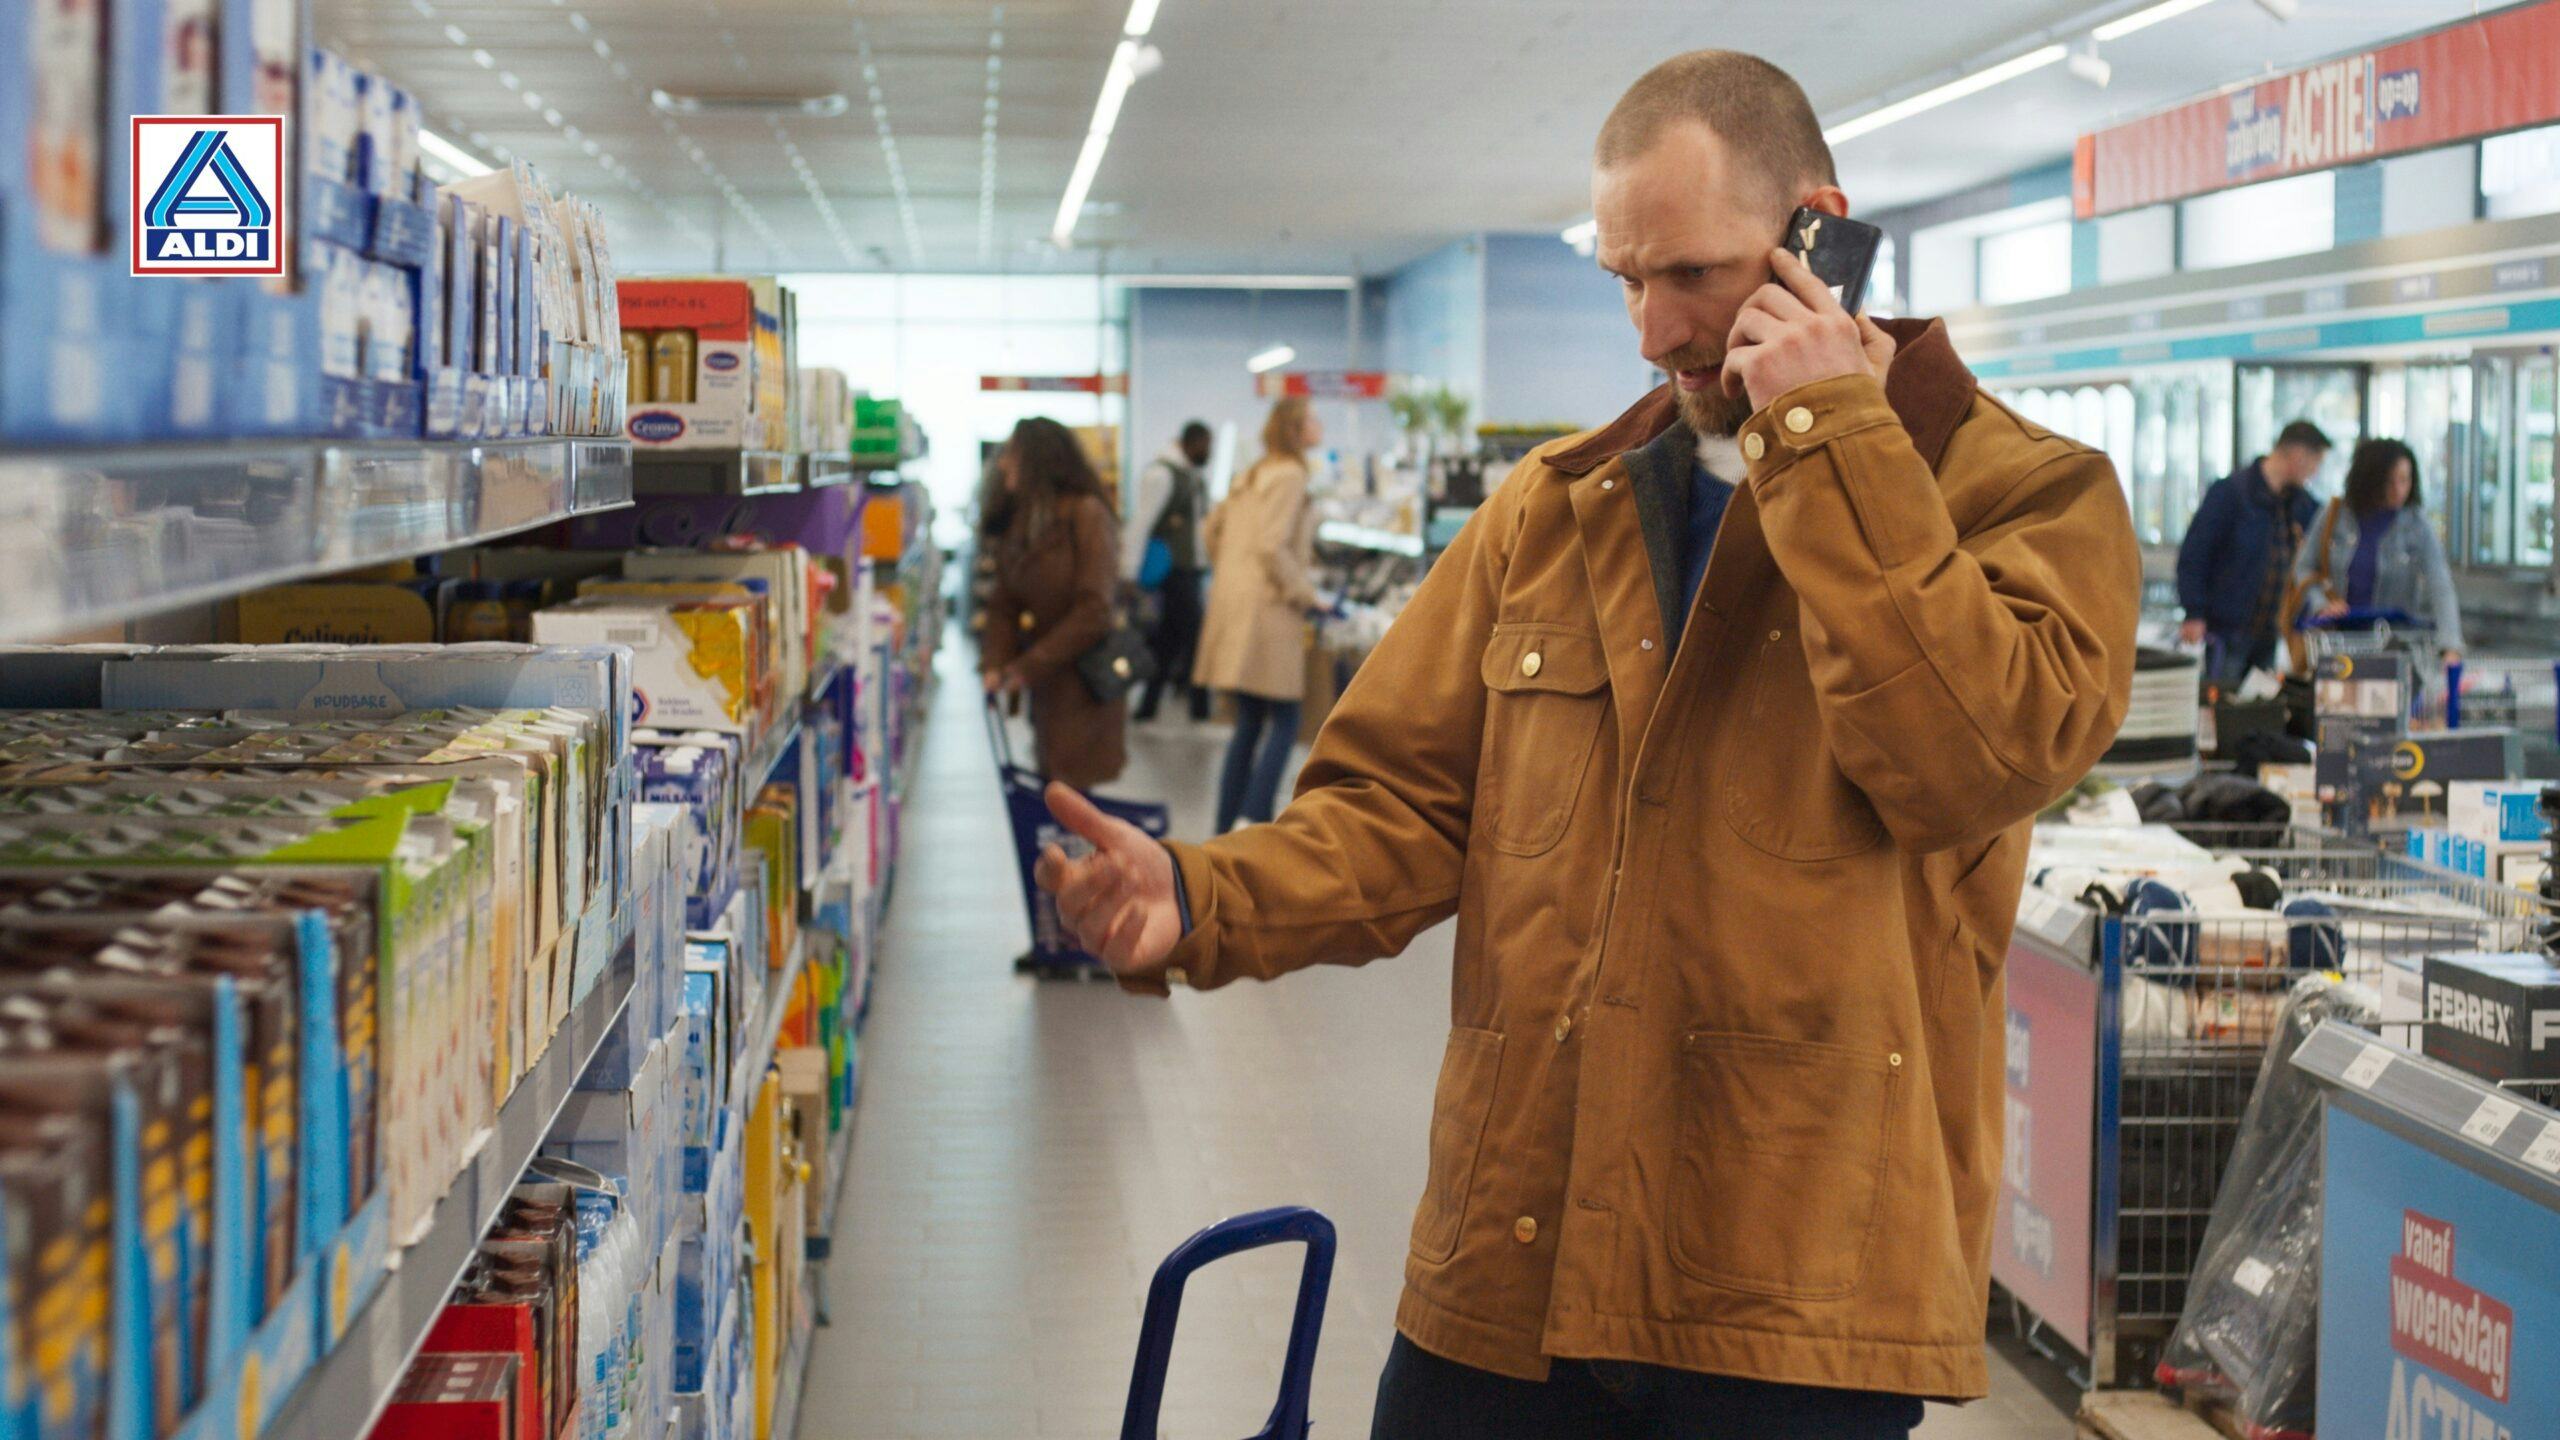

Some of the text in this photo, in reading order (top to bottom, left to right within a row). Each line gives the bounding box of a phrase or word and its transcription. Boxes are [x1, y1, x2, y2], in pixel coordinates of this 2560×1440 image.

[313, 695, 388, 708] HOUDBARE
[2428, 981, 2511, 1047] FERREX
[2405, 1216, 2451, 1277] vanaf
[2393, 1275, 2508, 1398] woensdag
[2385, 1358, 2512, 1440] ACTI
